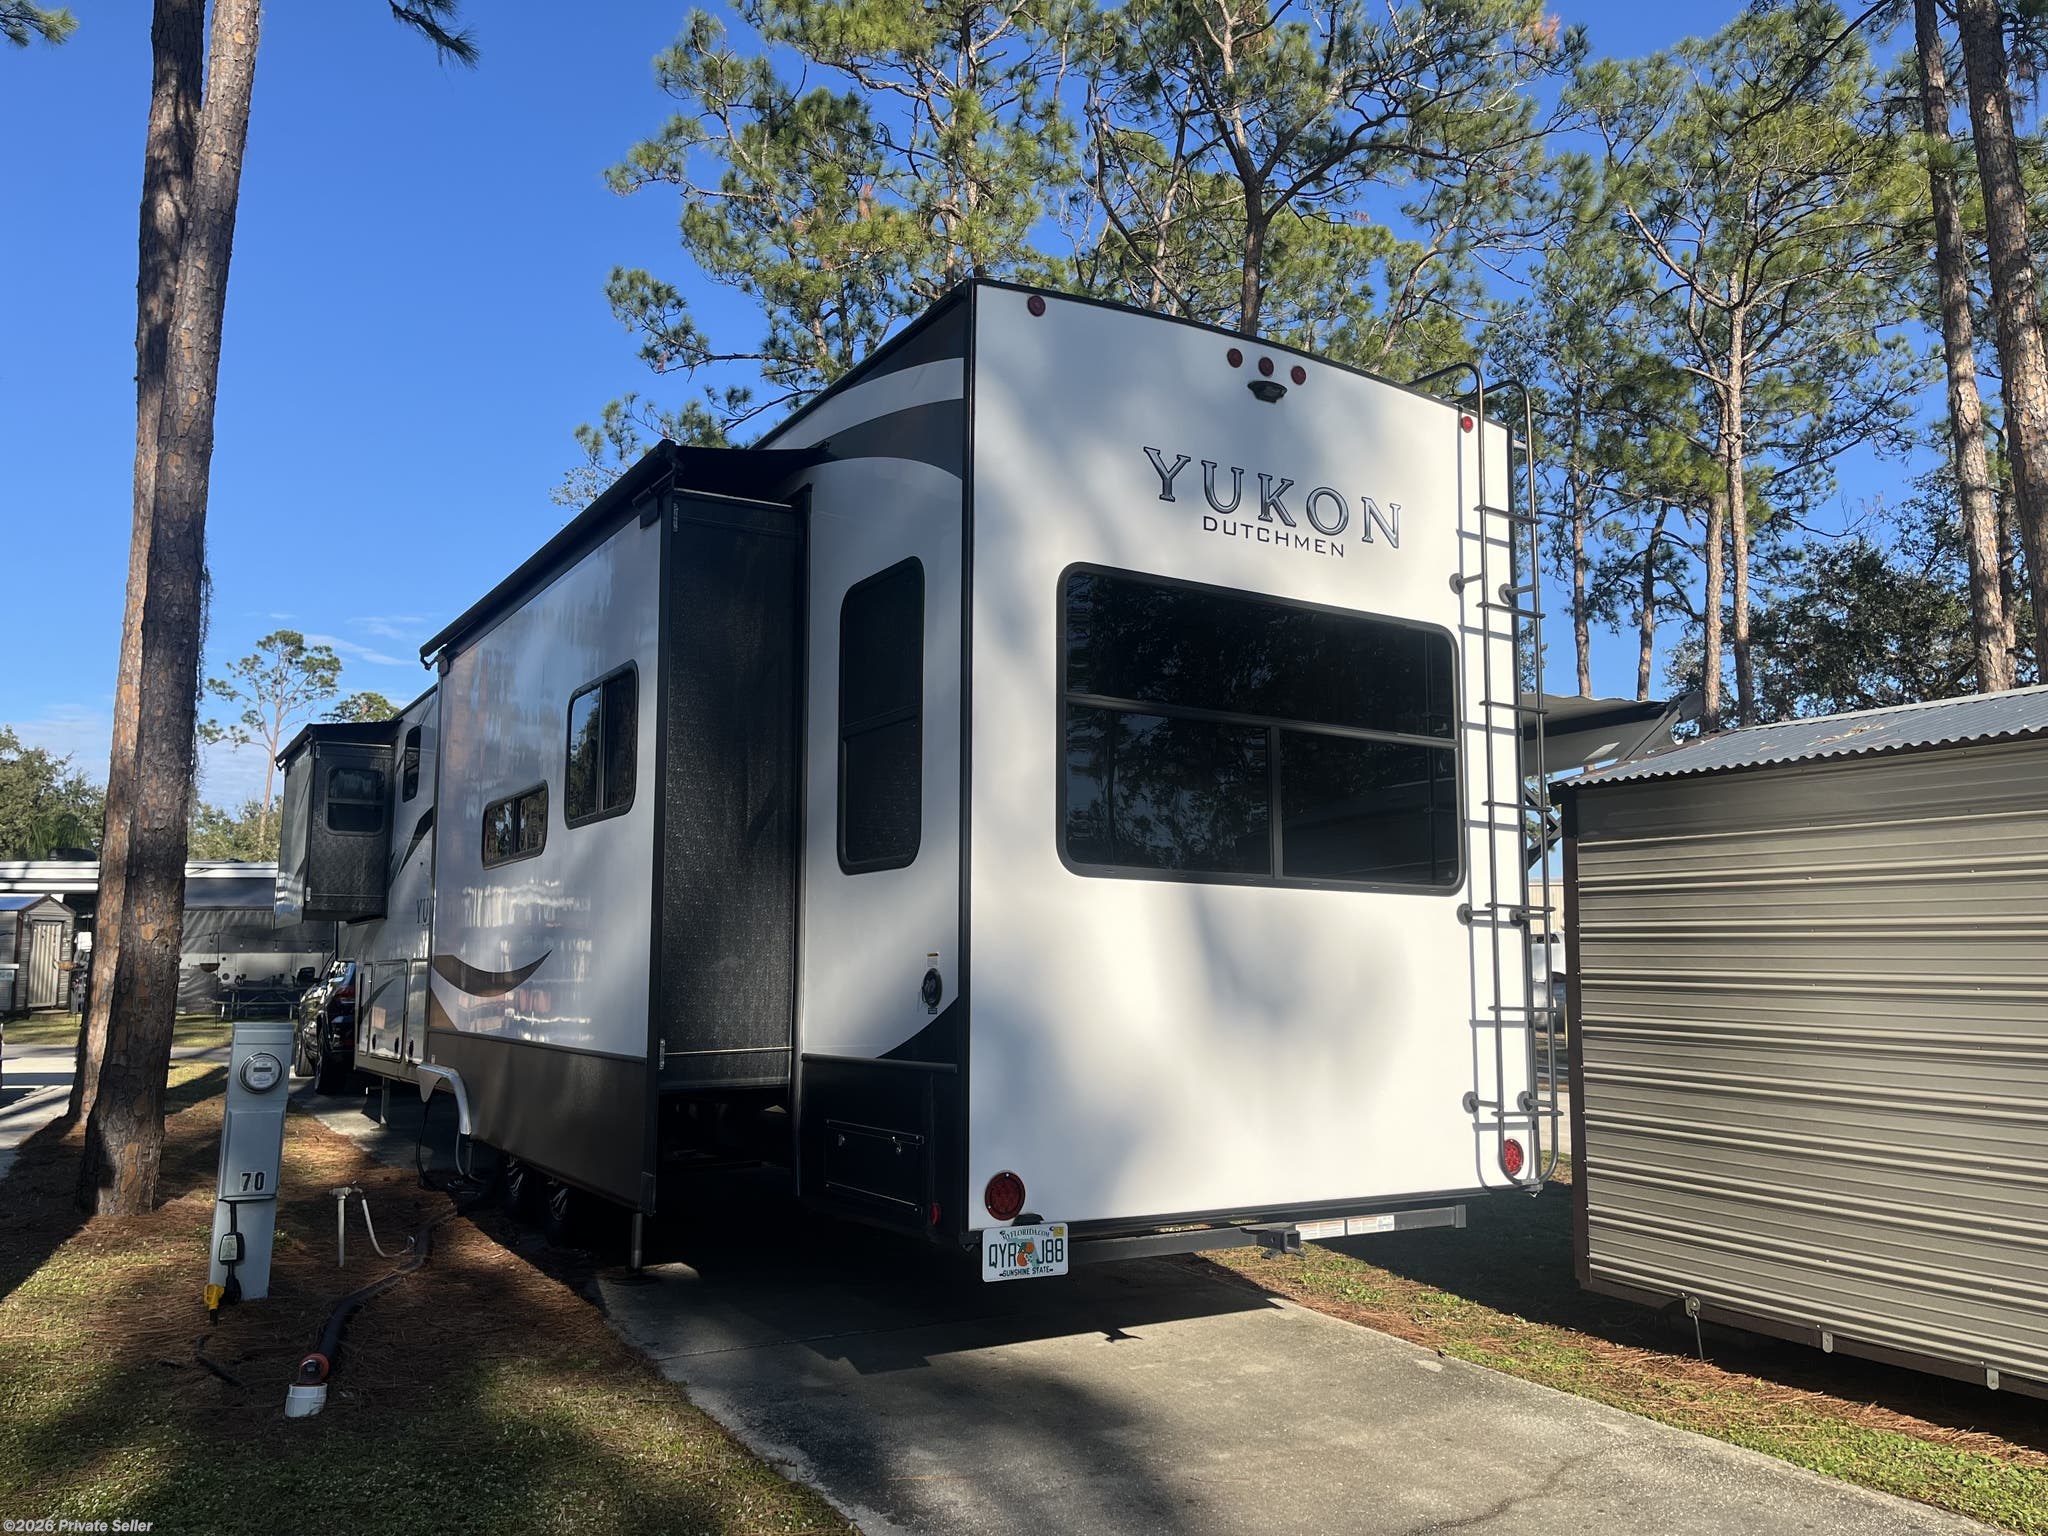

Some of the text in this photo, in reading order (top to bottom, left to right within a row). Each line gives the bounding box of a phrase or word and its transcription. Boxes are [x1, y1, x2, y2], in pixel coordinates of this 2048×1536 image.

[1143, 446, 1401, 549] YUKON
[1203, 516, 1344, 557] DUTCHMEN
[416, 898, 432, 923] YU
[241, 1172, 265, 1192] 70
[988, 1238, 1064, 1268] QYR J88
[1002, 1266, 1050, 1277] SUNSHINE STATE
